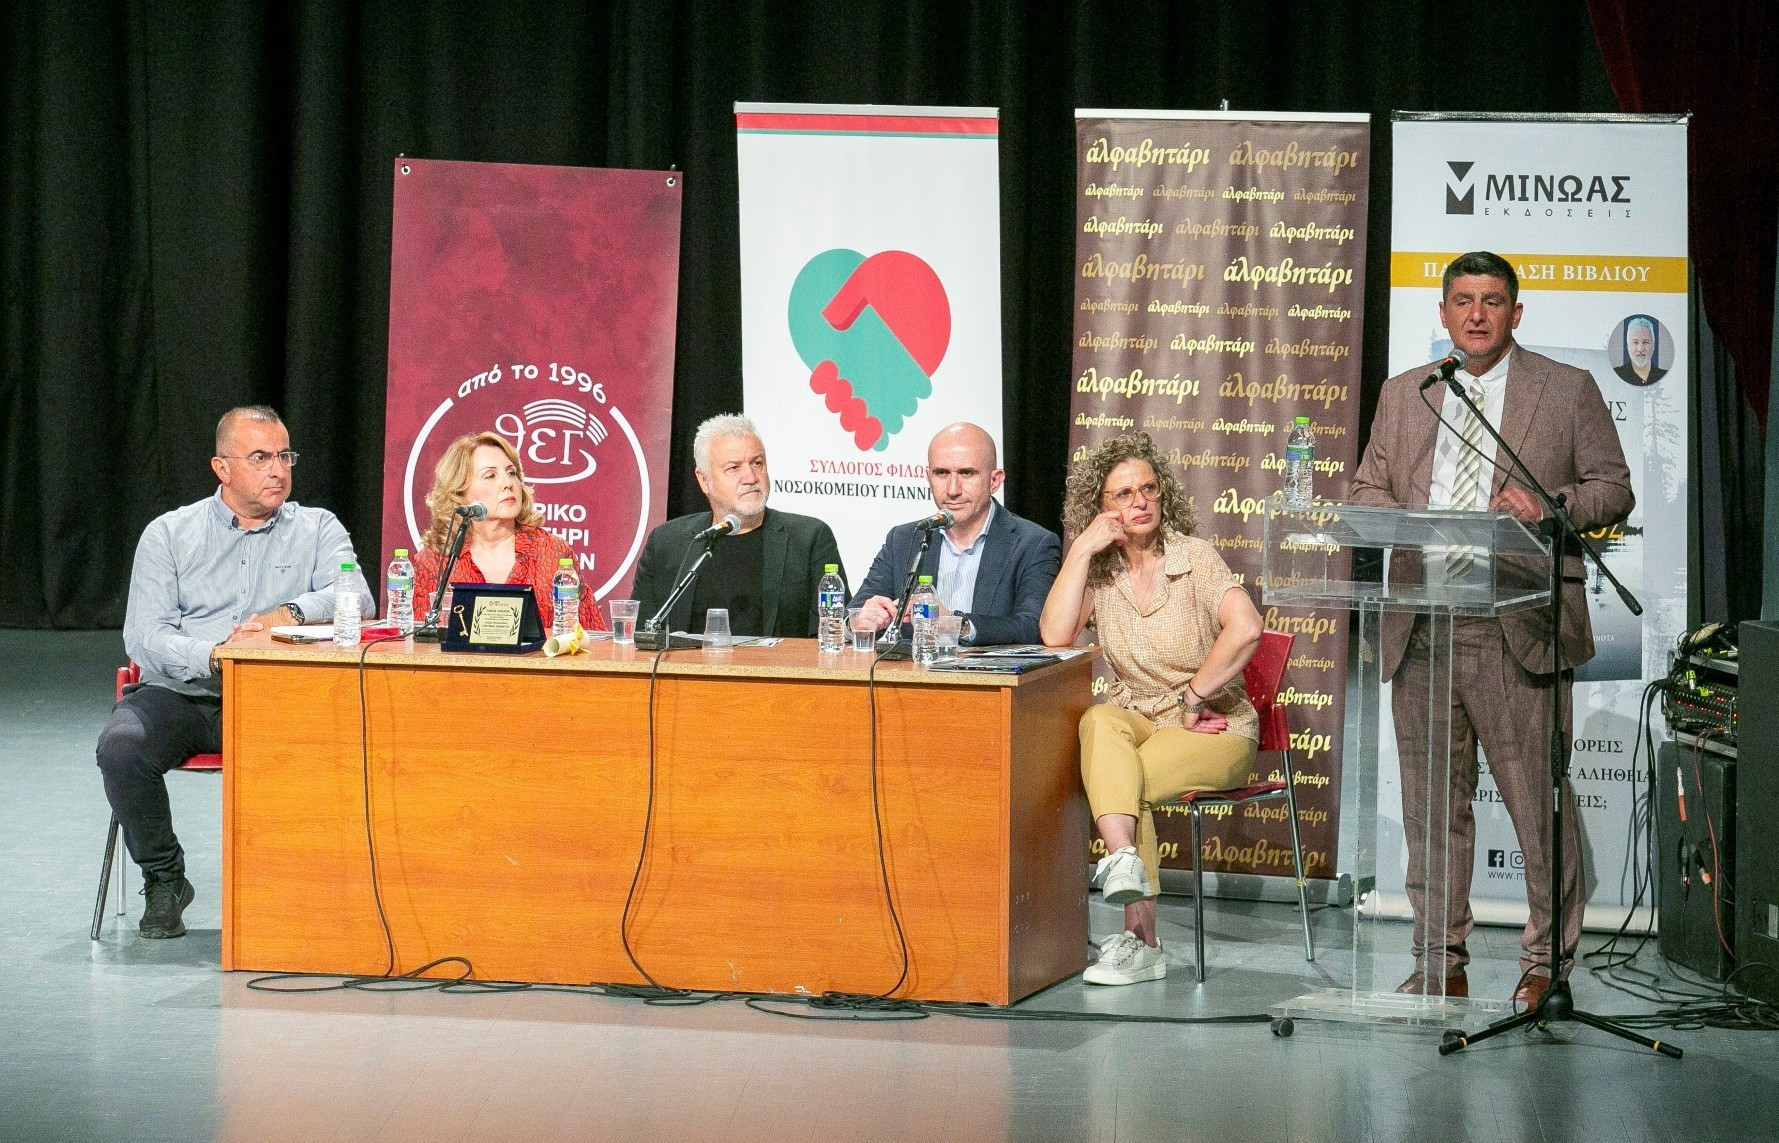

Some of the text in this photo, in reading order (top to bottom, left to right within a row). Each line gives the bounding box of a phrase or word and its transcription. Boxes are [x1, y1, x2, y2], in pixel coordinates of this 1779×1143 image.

[1485, 174, 1631, 203] ΜΙΝΩΑΣ
[1485, 208, 1631, 218] ΕΚΔΟΣΕΙΣ
[1563, 265, 1651, 282] ΒΙΒΛΙΟΥ
[457, 362, 607, 404] από το 1996
[810, 459, 883, 476] ΣΥΛΛΟΓΟΣ
[774, 479, 931, 500] ΝΟΣΟΚΟΜΕΙΟΥ ΓΙΑΝΝΙ
[1574, 739, 1623, 753] ΟΡΕΙΣ
